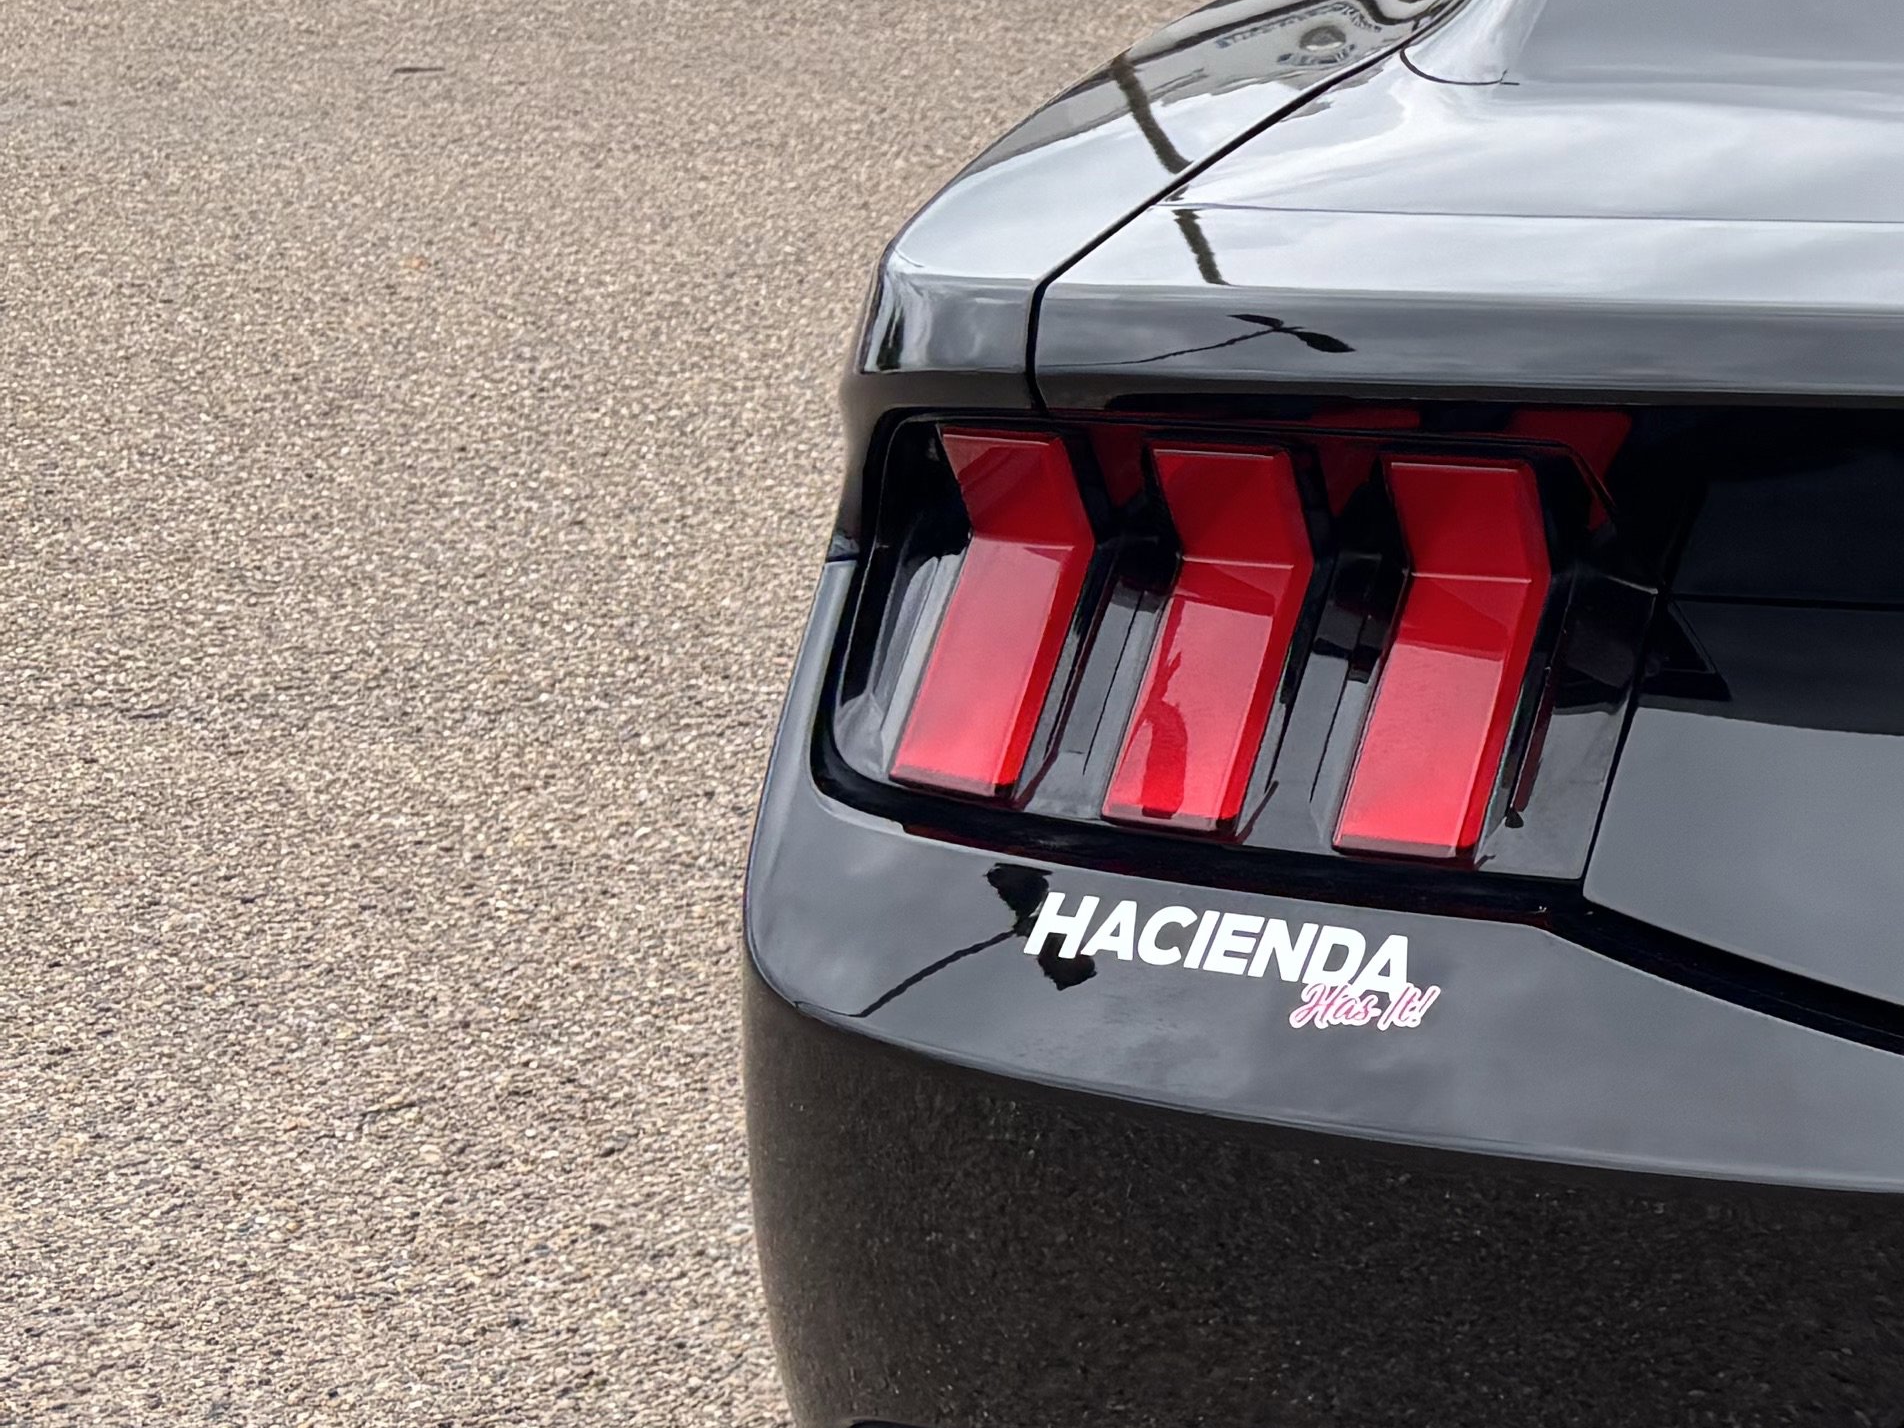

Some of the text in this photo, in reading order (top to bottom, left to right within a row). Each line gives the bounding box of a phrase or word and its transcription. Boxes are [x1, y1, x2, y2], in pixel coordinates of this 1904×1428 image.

[1023, 891, 1409, 993] HACIENDA
[1290, 983, 1441, 1031] Has It!
